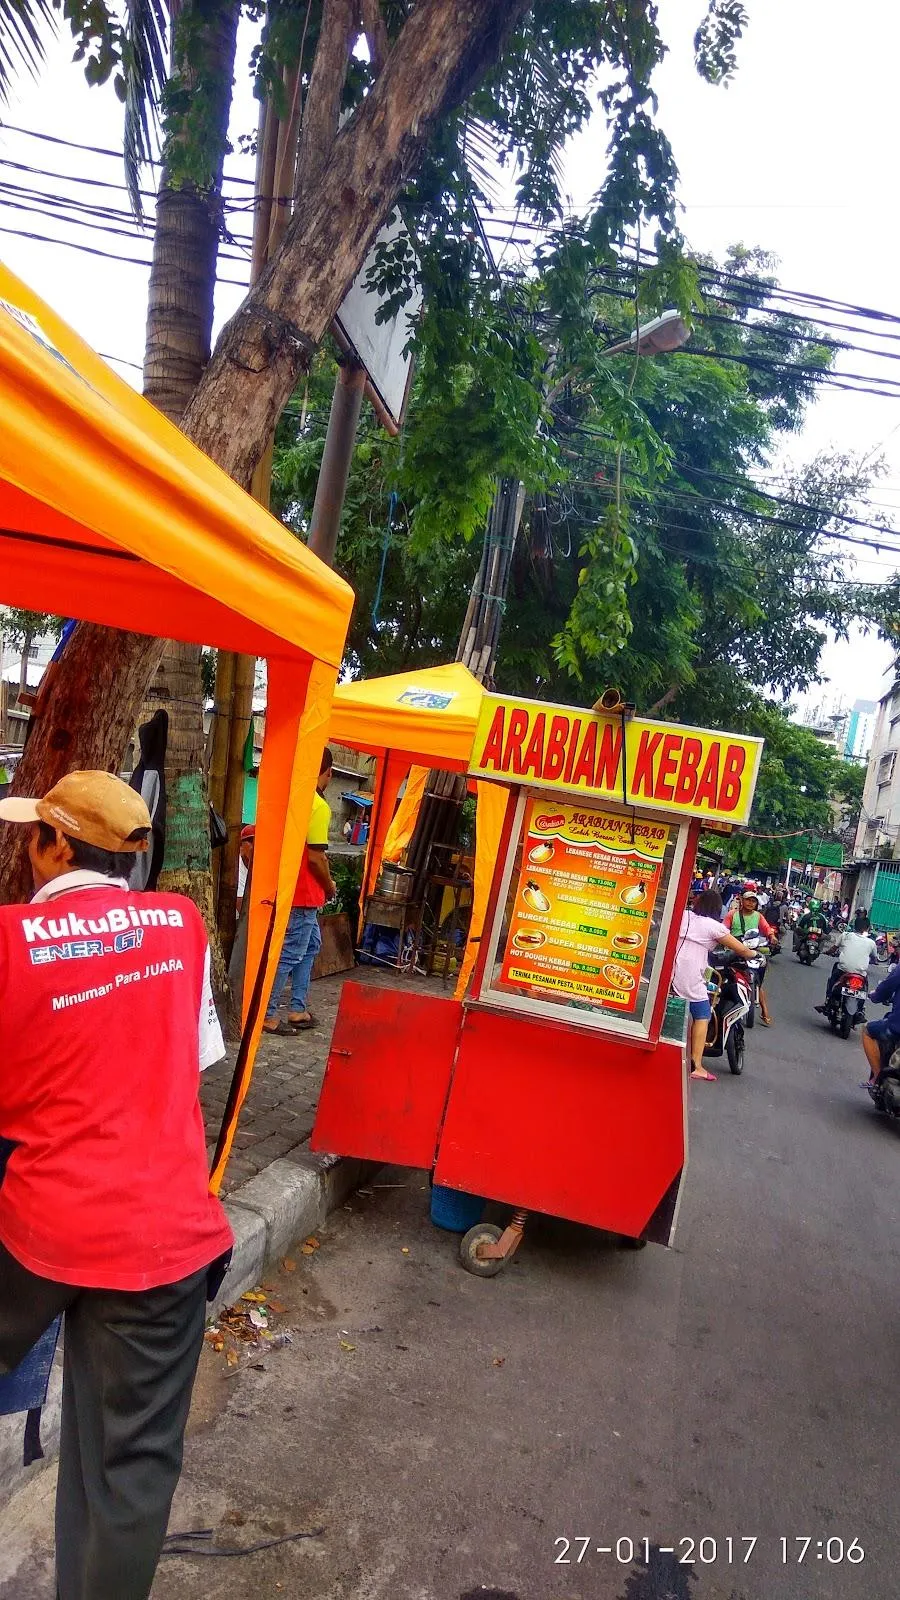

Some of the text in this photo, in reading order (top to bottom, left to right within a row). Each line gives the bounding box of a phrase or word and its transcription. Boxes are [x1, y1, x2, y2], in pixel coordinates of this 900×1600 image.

[479, 705, 746, 811] ARABIAN KEBAB
[568, 813, 665, 840] ARABIAN KEBAB
[565, 847, 593, 858] LEBANESE
[593, 852, 612, 861] KEBAB
[612, 855, 628, 865] KECIL
[526, 865, 552, 875] LEBANESE
[552, 870, 570, 879] KEBAB
[570, 873, 588, 882] BESAR
[557, 893, 588, 905] LEBANESE
[590, 899, 610, 910] KEBAB
[22, 906, 184, 942] KukuBima
[517, 911, 548, 923] BURGER
[550, 918, 577, 929] KEBAB
[30, 928, 144, 965] ENER-G!
[548, 937, 576, 948] SUPER
[577, 943, 609, 955] BURGER
[510, 949, 523, 957] HOT
[524, 952, 548, 962] DOUGH
[548, 957, 571, 967] KEBAB
[51, 958, 184, 1011] Minuman Para JUARA
[512, 969, 531, 979] TERIMA
[532, 974, 556, 985] PESANAN
[595, 987, 615, 998] ARISAN
